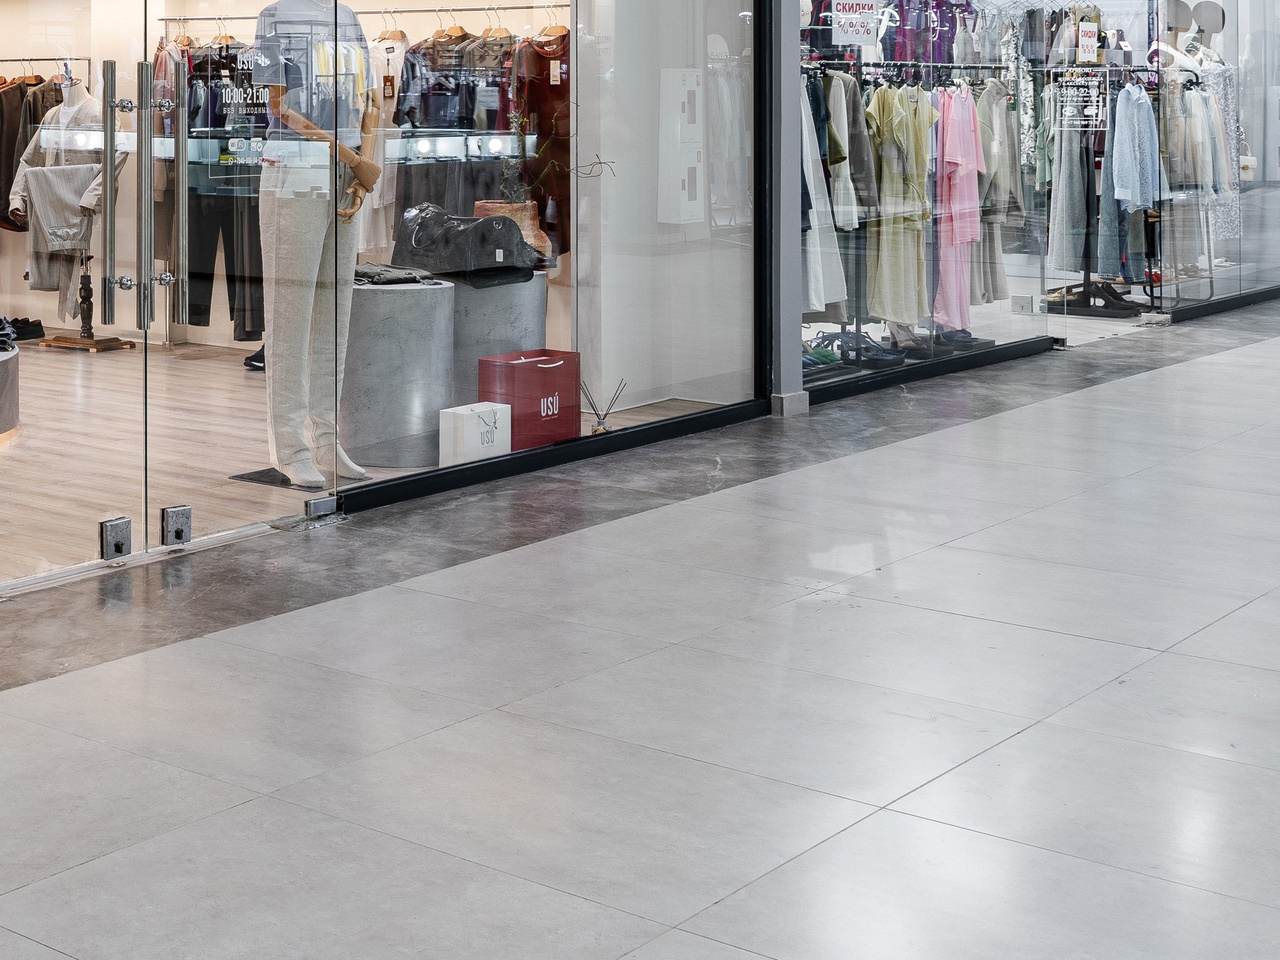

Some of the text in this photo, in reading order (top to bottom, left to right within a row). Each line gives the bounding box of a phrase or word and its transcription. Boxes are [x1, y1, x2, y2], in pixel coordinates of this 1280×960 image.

[835, 2, 874, 15] СКИДКИ
[221, 87, 270, 104] 10:00-21:00
[541, 392, 558, 416] USÚ
